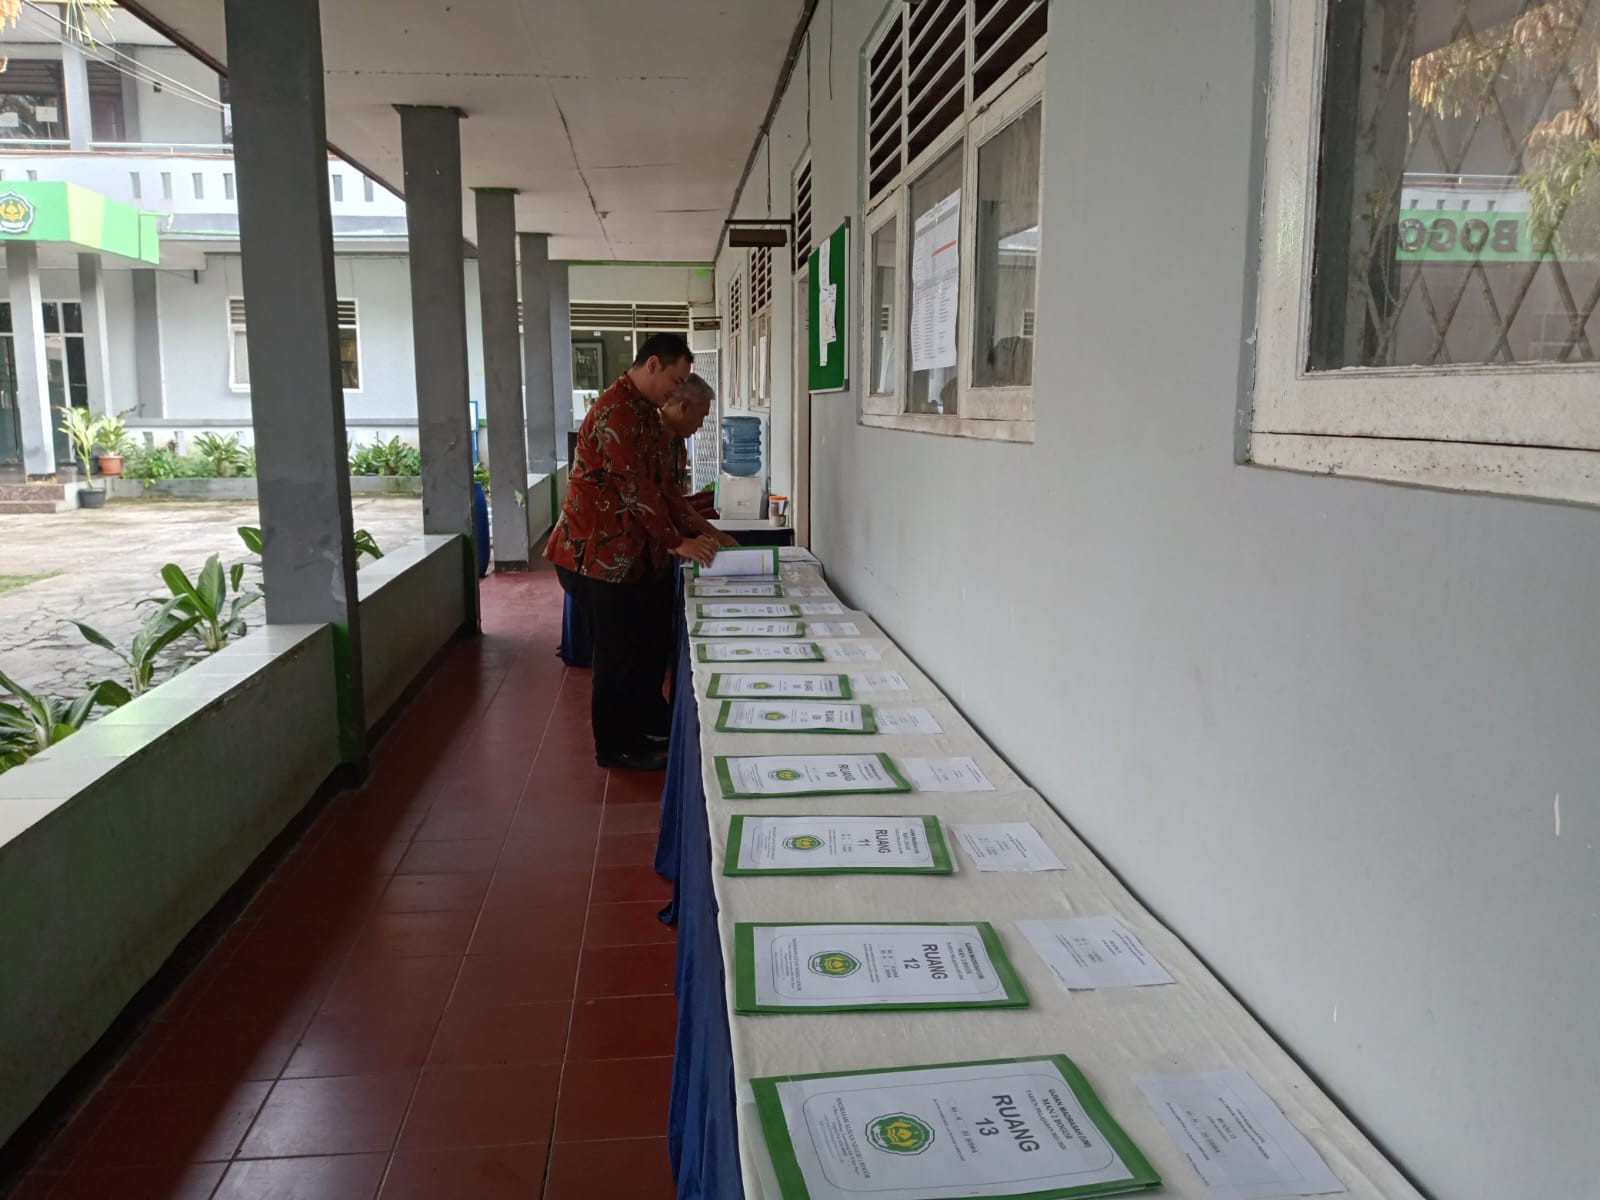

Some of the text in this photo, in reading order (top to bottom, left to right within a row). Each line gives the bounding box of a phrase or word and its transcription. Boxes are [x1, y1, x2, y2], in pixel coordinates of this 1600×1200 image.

[857, 838, 870, 846] 11
[874, 829, 890, 853] RUANG
[901, 957, 921, 969] 12
[920, 944, 950, 979] RUANG
[989, 1094, 1041, 1153] RUANG
[1039, 1098, 1057, 1113] MAN
[1052, 1118, 1073, 1139] BOGOR
[1046, 1088, 1065, 1105] UJIAN
[1057, 1106, 1084, 1135] MADRASAH
[975, 1117, 1000, 1137] 13
